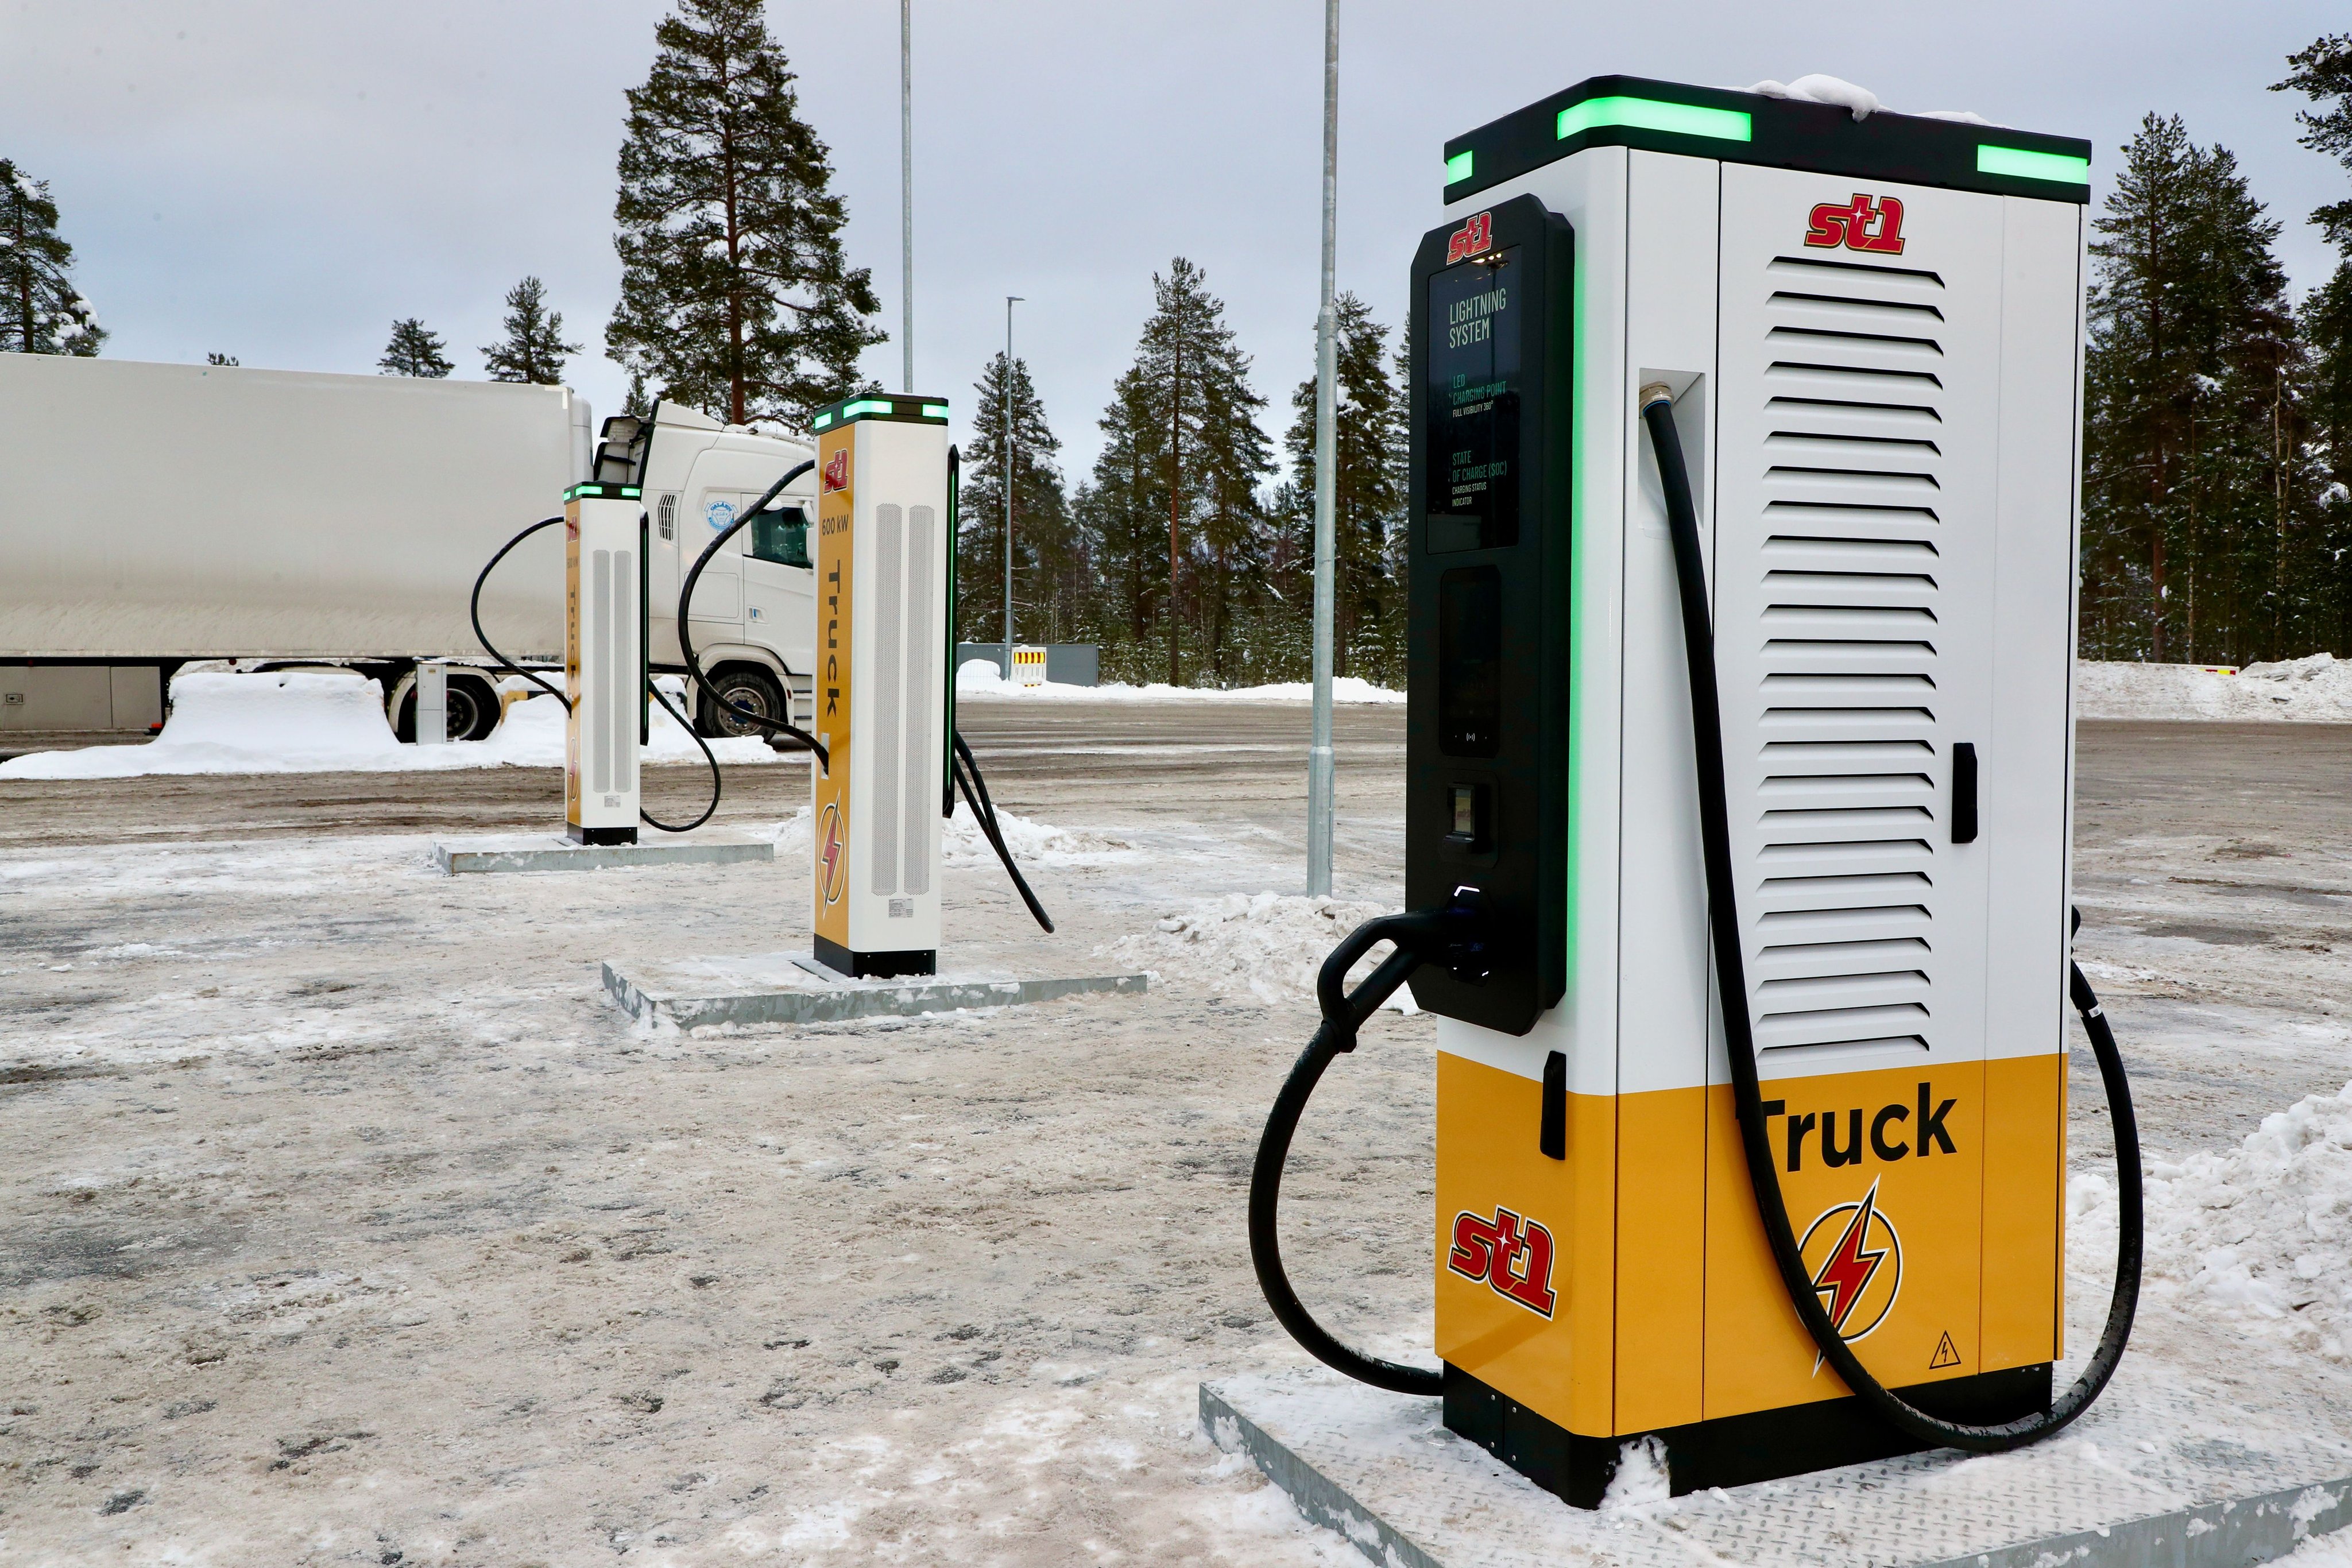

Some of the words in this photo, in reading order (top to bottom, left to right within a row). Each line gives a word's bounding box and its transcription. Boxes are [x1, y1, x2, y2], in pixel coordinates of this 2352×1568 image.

[1803, 192, 1906, 255] st1
[1446, 211, 1493, 265] st1
[1449, 288, 1506, 325] LIGHTNING
[1449, 317, 1490, 349] SYSTEM
[1453, 374, 1465, 389] LED
[1453, 386, 1485, 405] CHARGING
[1486, 381, 1507, 398] POINT
[1453, 408, 1463, 418] FULL
[1463, 404, 1483, 416] VISIBILITY
[1452, 451, 1472, 466] STATE
[823, 448, 849, 495] st1
[1452, 469, 1461, 482] OF
[1462, 464, 1487, 481] CHARGE
[1488, 460, 1507, 478] (SOC)
[1452, 484, 1472, 495] CHARGING
[1472, 482, 1487, 492] STATUS
[1452, 496, 1472, 507] INDICATOR
[822, 517, 835, 536] 600
[837, 514, 849, 534] kW
[826, 559, 841, 718] Truck
[1446, 1204, 1558, 1322] st1
